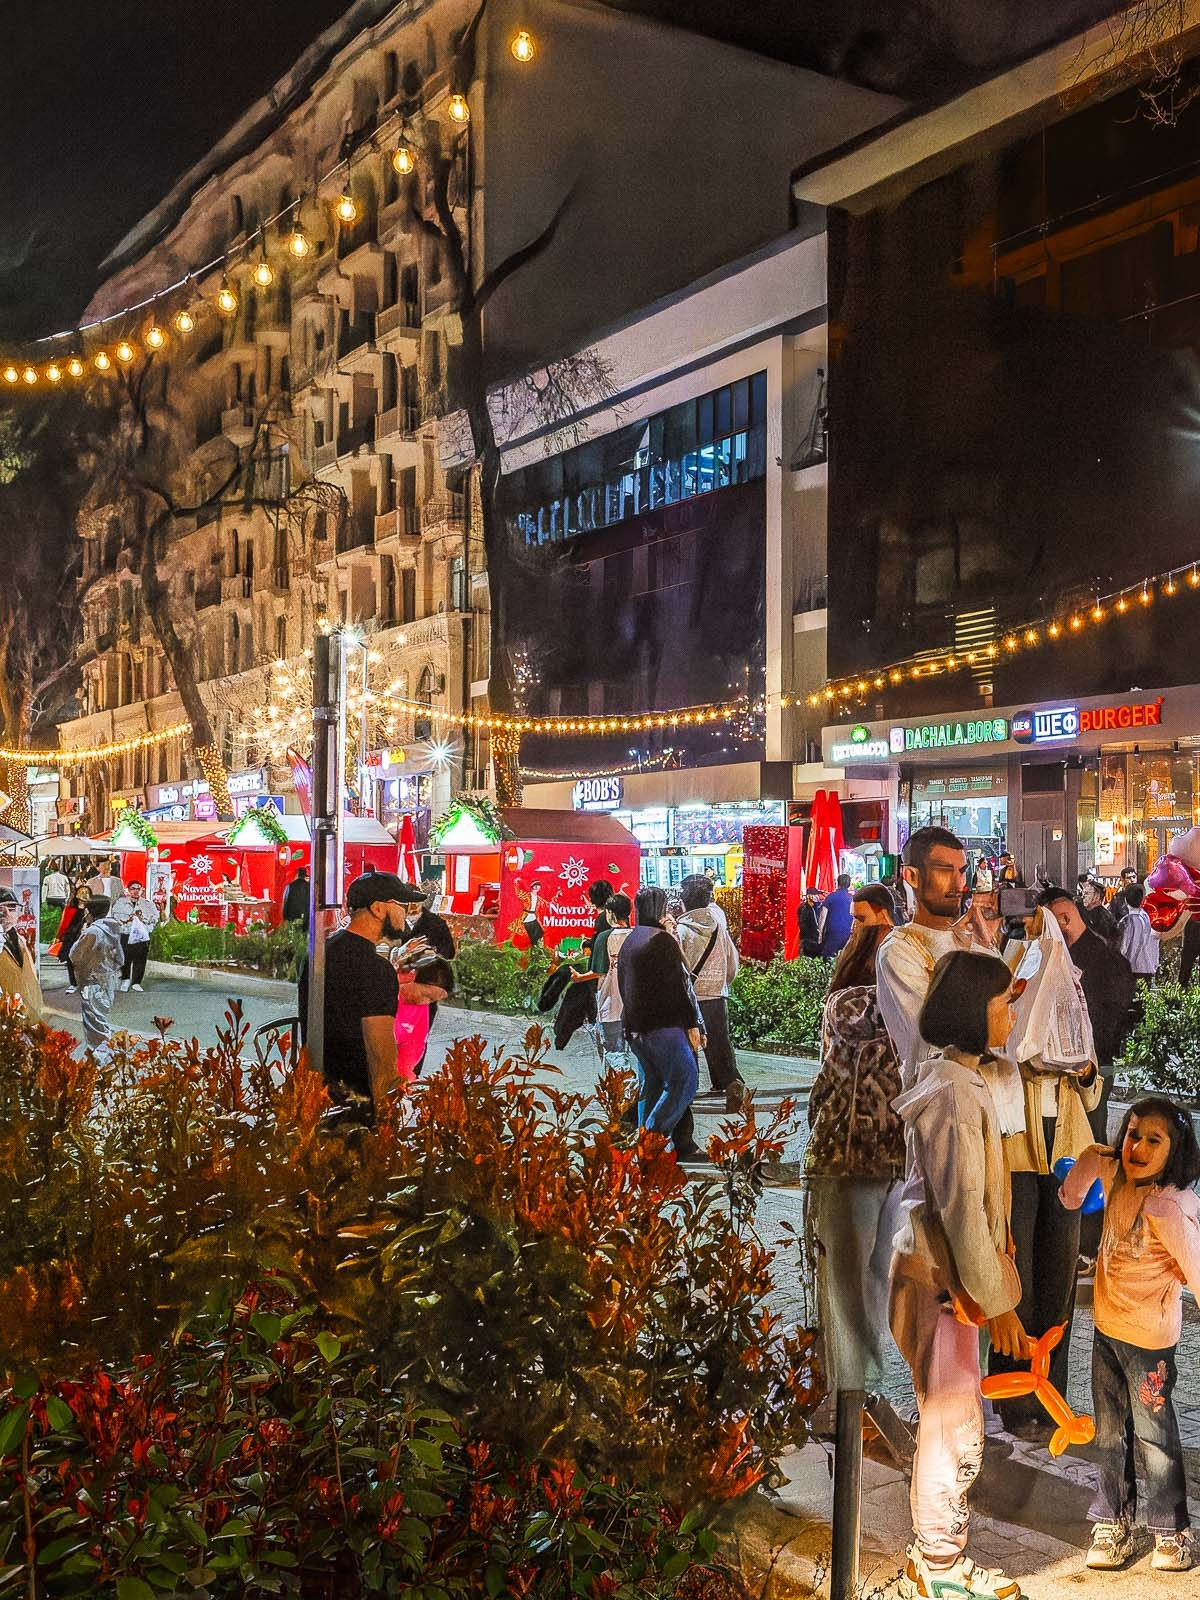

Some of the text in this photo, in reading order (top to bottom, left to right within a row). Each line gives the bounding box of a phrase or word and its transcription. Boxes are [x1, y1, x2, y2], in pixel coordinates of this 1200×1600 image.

[1035, 704, 1158, 736] ШЕФ BURGER
[584, 777, 619, 801] BOB'S
